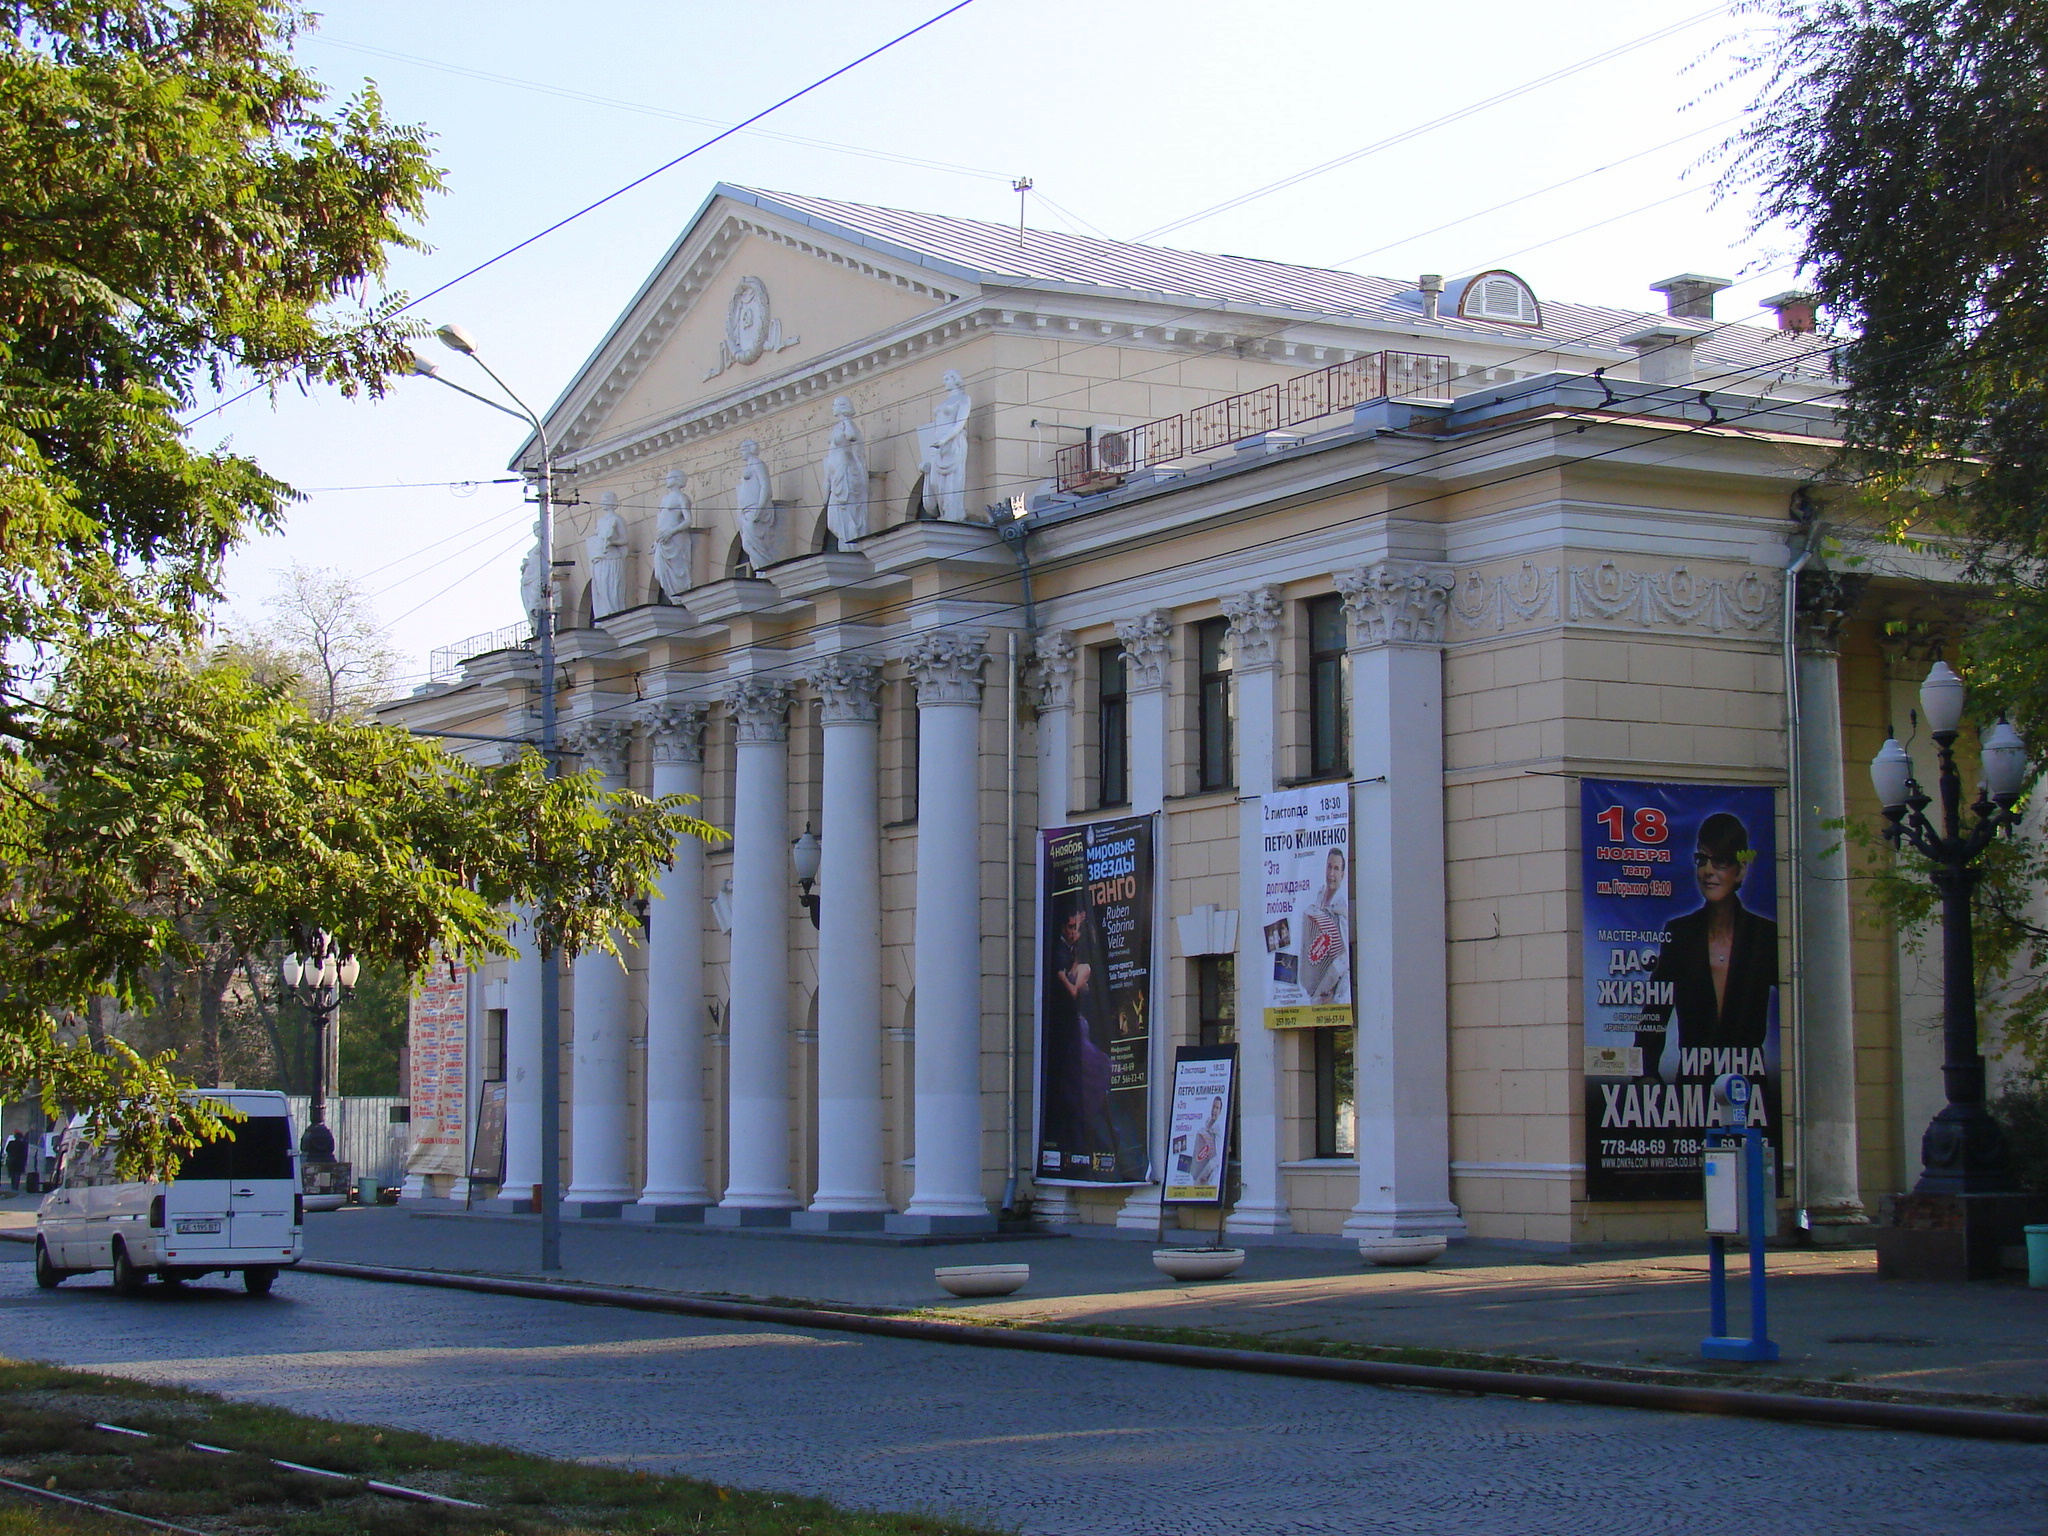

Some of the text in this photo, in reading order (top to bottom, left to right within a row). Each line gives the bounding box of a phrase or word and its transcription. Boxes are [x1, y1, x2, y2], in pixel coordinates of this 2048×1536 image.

[1320, 796, 1341, 810] 18:30
[1264, 805, 1269, 820] 2
[1597, 805, 1668, 844] 18
[1055, 840, 1083, 858] ноября
[1087, 838, 1136, 862] мировые
[1265, 834, 1292, 852] ПЕТРО
[1597, 846, 1670, 863] НОЯБРЯ
[1088, 855, 1135, 881] звезды
[1622, 865, 1651, 879] театр
[1089, 876, 1136, 906] танго
[1597, 878, 1672, 897] им. Горького 19:00
[1107, 905, 1130, 919] Ruben
[1107, 919, 1134, 935] Sabrina
[1598, 929, 1672, 943] МАСТЕР-КЛАСС
[1108, 933, 1125, 949] Veliz
[1597, 980, 1674, 1006] ЖИЗНИ
[1681, 1047, 1765, 1076] ИРИНА
[1601, 1084, 1768, 1128] ХАКАМАА
[1601, 1139, 1665, 1155] 778-48-69
